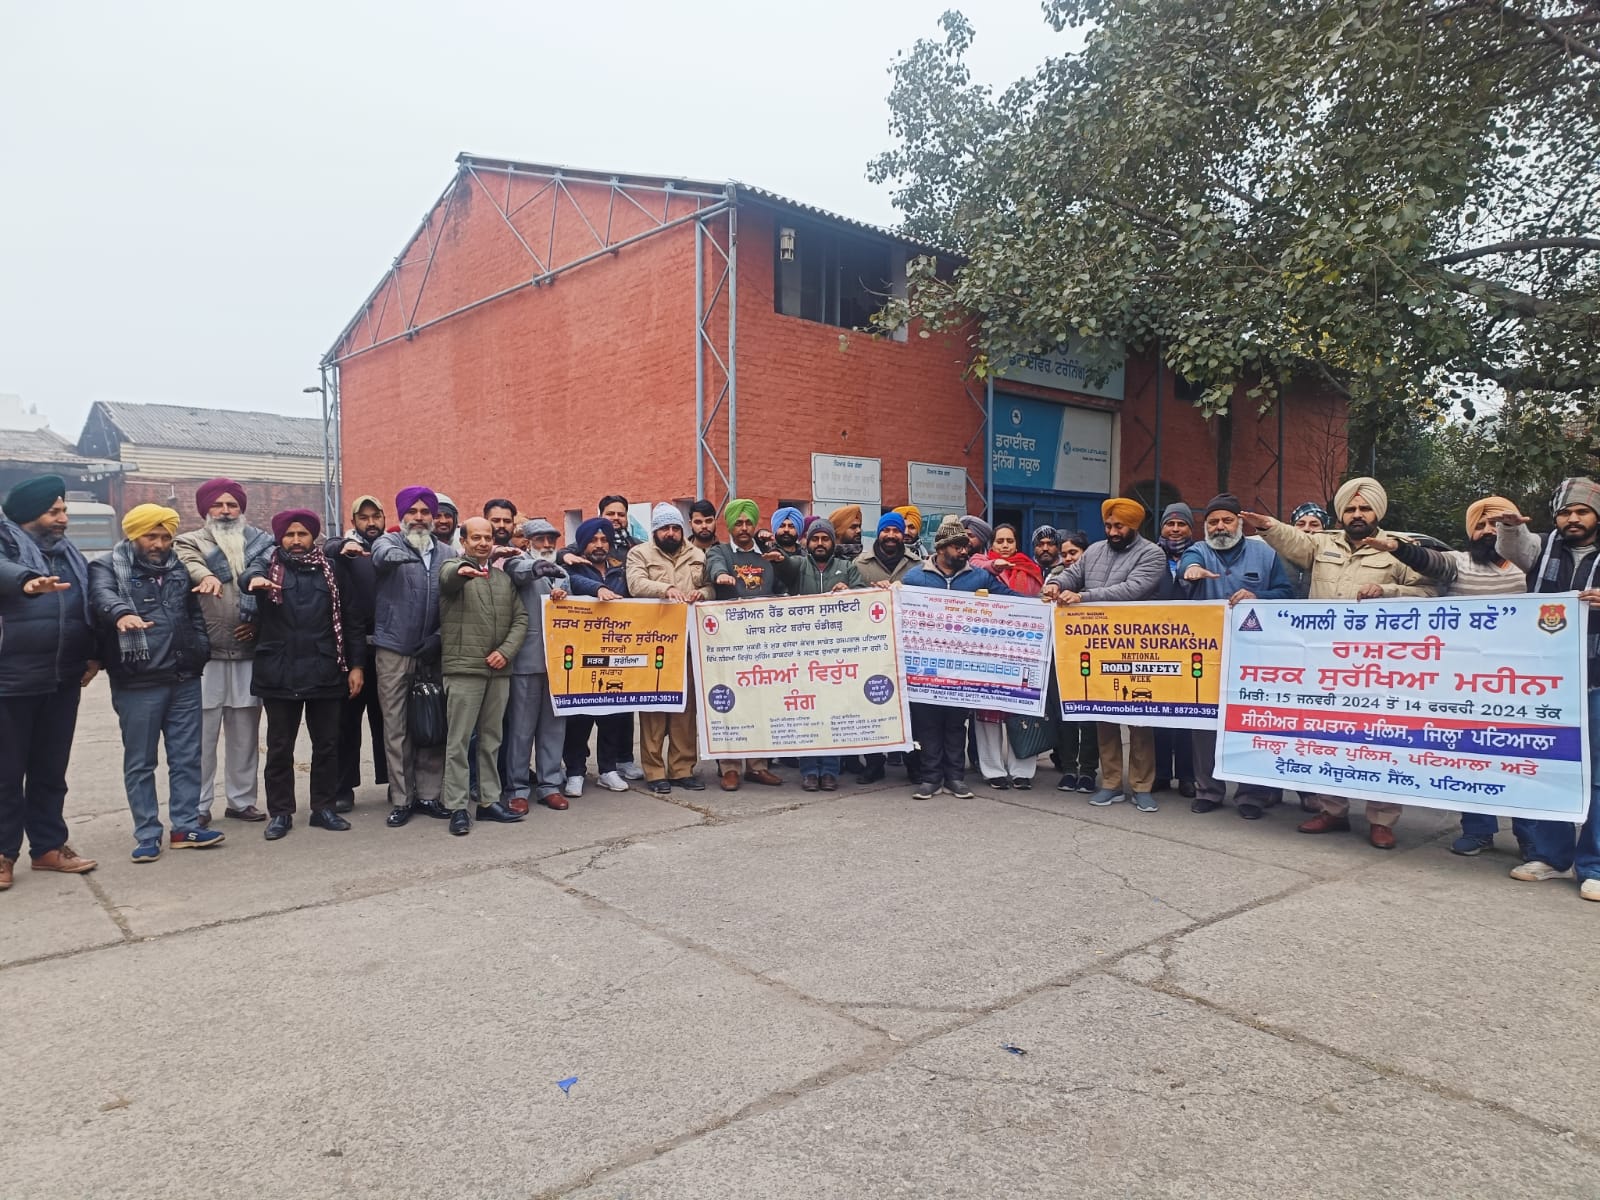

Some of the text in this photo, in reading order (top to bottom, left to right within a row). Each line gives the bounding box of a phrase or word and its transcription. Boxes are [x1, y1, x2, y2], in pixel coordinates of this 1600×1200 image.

[996, 432, 1035, 451] ਡਰਾਈਵਰ
[1019, 458, 1040, 476] ਸਕੂਲ
[726, 607, 764, 621] ਇੰਡੀਅਨ
[788, 605, 815, 617] ਕਰਾਸ
[820, 600, 860, 617] ਸੁਸਾਇਟੀ
[1277, 605, 1517, 630] “ਅਸਲੀ ਰੋਡ ਸੇਫਟੀ ਹੀਰੋ ਬਣੋ”
[584, 617, 631, 632] ਸੁਰੱਖਿਆ
[746, 623, 766, 636] ਪੰਜਾਬ
[769, 624, 786, 633] ਸਟੇਟ
[1065, 624, 1195, 636] SADAK SURAKSHA,
[602, 630, 678, 645] ਜੀਵਨ ਸੁਰੱਖਿਆ
[1085, 637, 1218, 650] JEEVAN SURAKSHA
[1332, 635, 1445, 660] ਰਾਸ਼ਟਰੀ
[736, 659, 858, 687] ਨਸ਼ਿਆਂ ਵਿਰੁੱਧ
[1102, 663, 1179, 673] ROAD SAFETY
[1240, 663, 1564, 696] ਸੜਕ ਸੁਰੱਖਿਆ ਮਹੀਨਾ
[572, 695, 614, 705] Automobiles
[784, 689, 816, 711] ਜੰਗ
[1092, 705, 1142, 713] Automobiles
[1240, 688, 1562, 720] ਮਿਤੀ: 15 ਜਨਵਰੀ 2024 ਤੋਂ 14 ਫਰਵਰੀ 2024 ਤੱਕ
[1241, 712, 1556, 750] ਸੀਨੀਅਰ ਕਪਤਾਨ ਪੁਲਿਸ, ਜਿਲ੍ਹਾ ਪਟਿਆਲਾ
[1252, 736, 1539, 776] ਜਿਲ੍ਹਾ ਟ੍ਰੈਫਿਕ ਪੁਲਿਸ, ਪਟਿਆਲਾ ਅਤੇ
[1319, 762, 1381, 783] ਐਜੂਕੇਸ਼ਨ
[1430, 776, 1506, 796] ਪਟਿਆਲਾ
